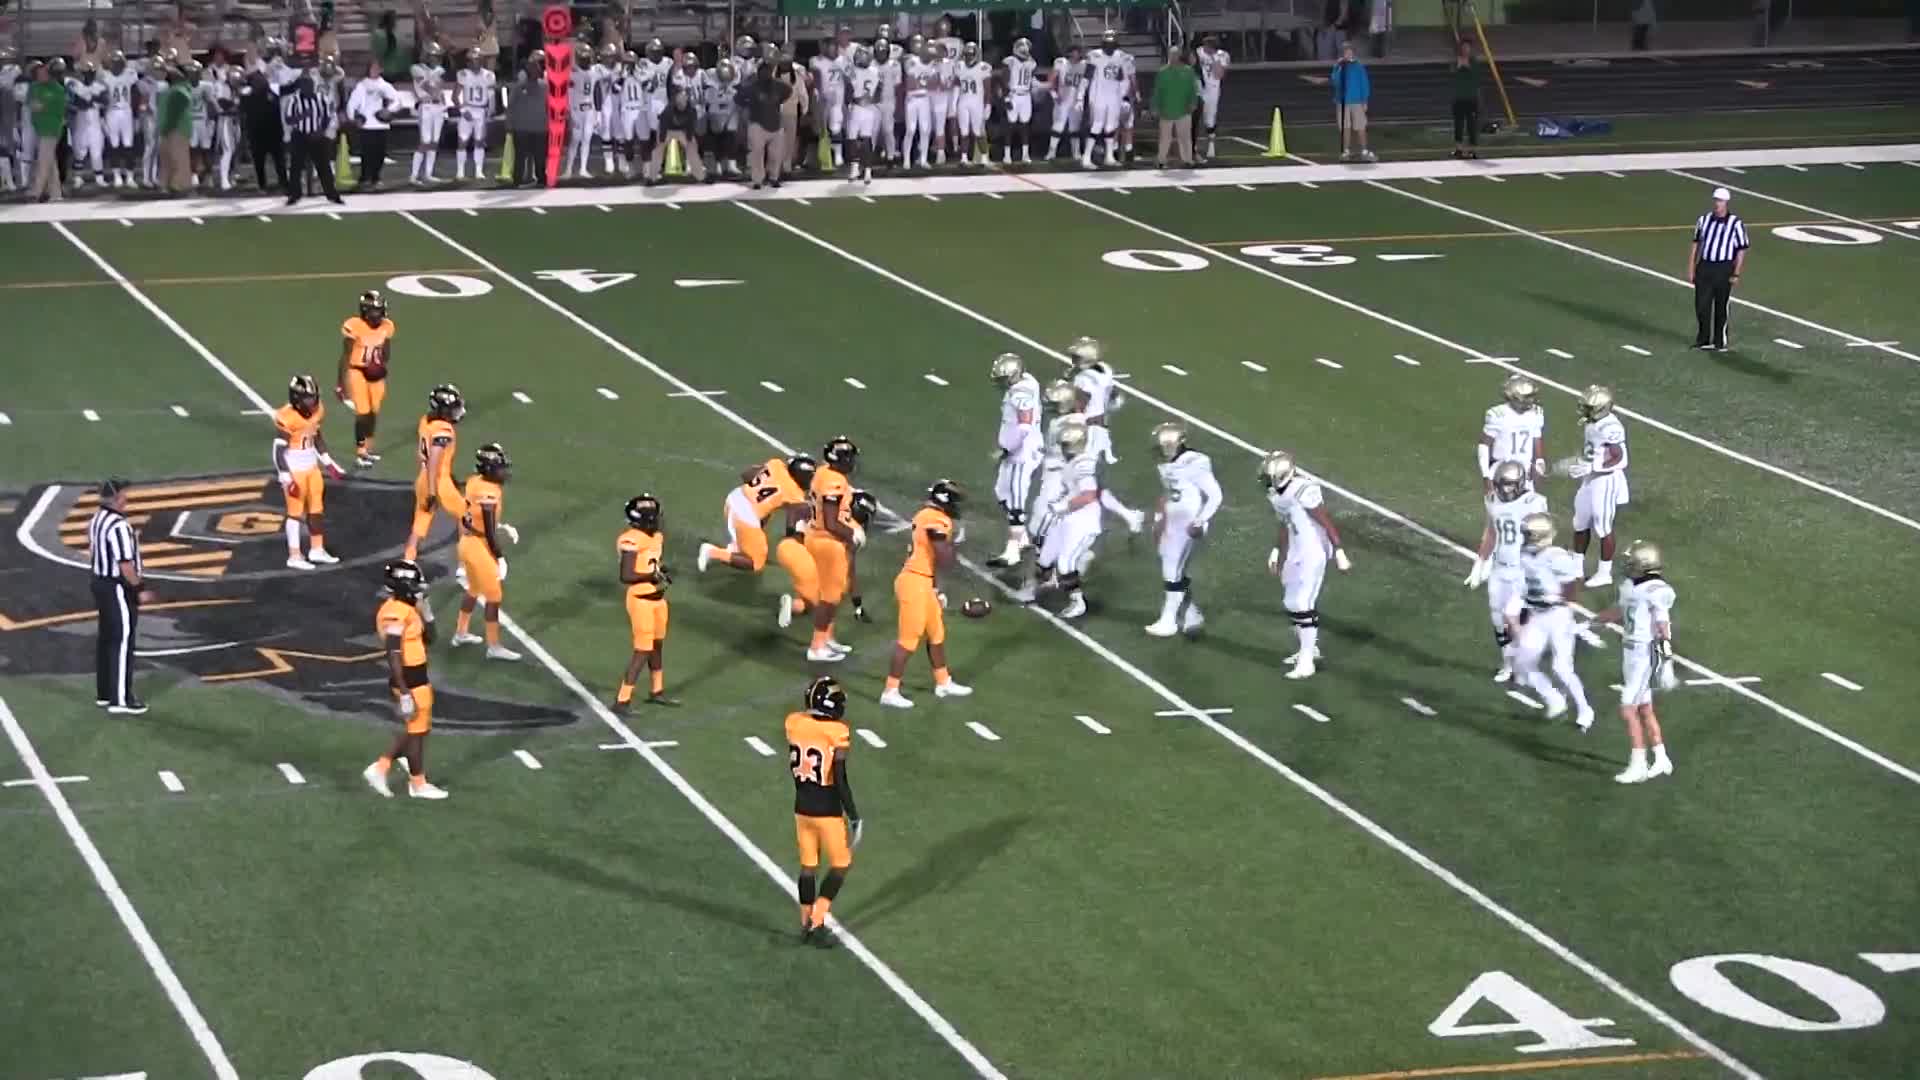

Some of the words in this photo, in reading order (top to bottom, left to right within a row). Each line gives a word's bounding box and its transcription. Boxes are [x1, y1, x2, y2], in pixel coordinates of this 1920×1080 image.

[1510, 431, 1530, 454] 17
[748, 469, 778, 503] 54
[1496, 518, 1518, 546] 18
[789, 744, 824, 785] 23
[1428, 953, 1886, 1053] 40
